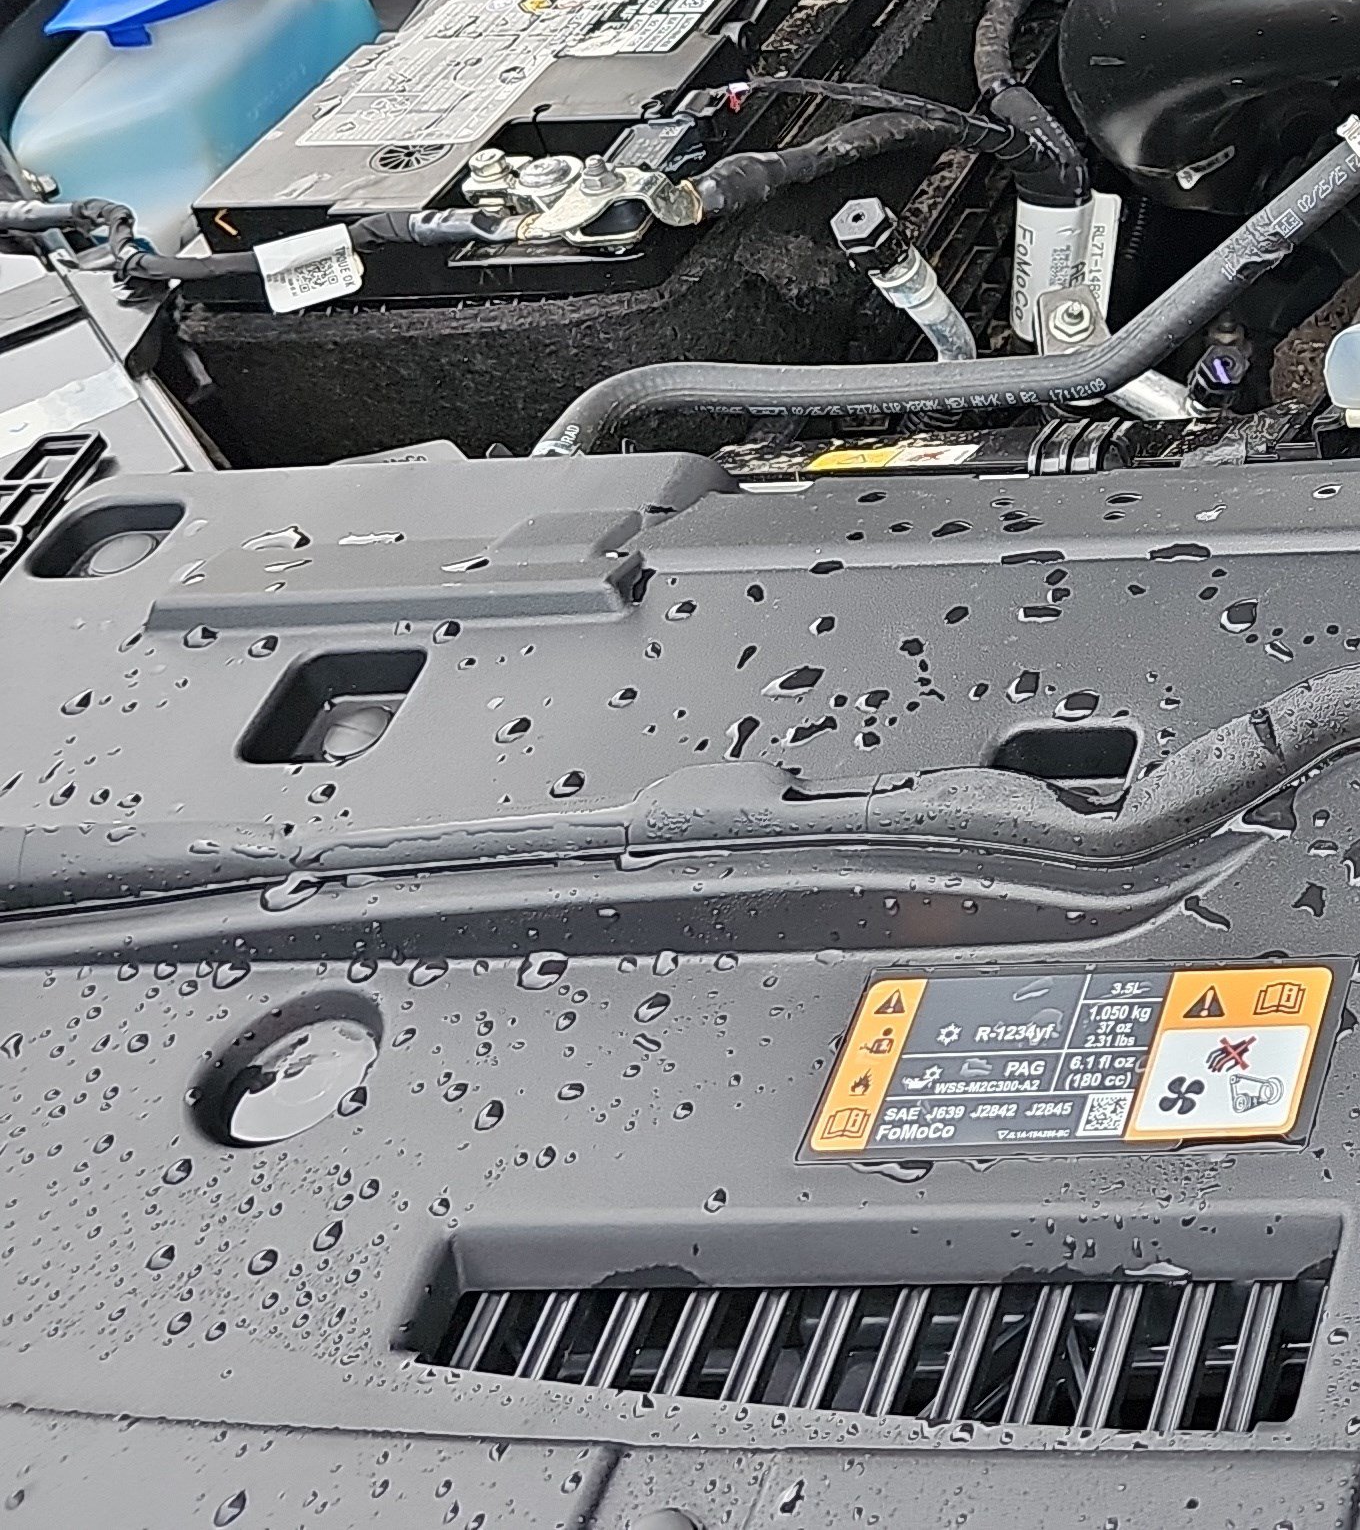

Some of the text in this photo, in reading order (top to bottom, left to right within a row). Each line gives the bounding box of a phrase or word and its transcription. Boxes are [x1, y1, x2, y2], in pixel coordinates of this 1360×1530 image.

[1297, 165, 1348, 213] 02/25/25
[342, 275, 356, 288] OK
[1014, 224, 1035, 321] FoMoCo
[1005, 392, 1016, 405] B
[1020, 391, 1040, 404] B2
[1049, 378, 1107, 404] 17:12:09
[560, 424, 580, 445] RAD
[1111, 982, 1142, 995] 3.5L
[1089, 1004, 1152, 1022] 1.050 kg
[974, 1022, 1056, 1044] R-1234yf
[1096, 1021, 1134, 1033] 37 oz
[1084, 1033, 1136, 1047] 2.31 lbs
[1003, 1060, 1046, 1077] PAG
[1070, 1054, 1136, 1070] 6.1 fl oz
[933, 1079, 1041, 1094] WSS-M2C300-A2
[1065, 1071, 1132, 1090] (180 cc)
[884, 1101, 1074, 1122] SAE J639 J2842 J2845
[875, 1122, 956, 1141] FoMoCo
